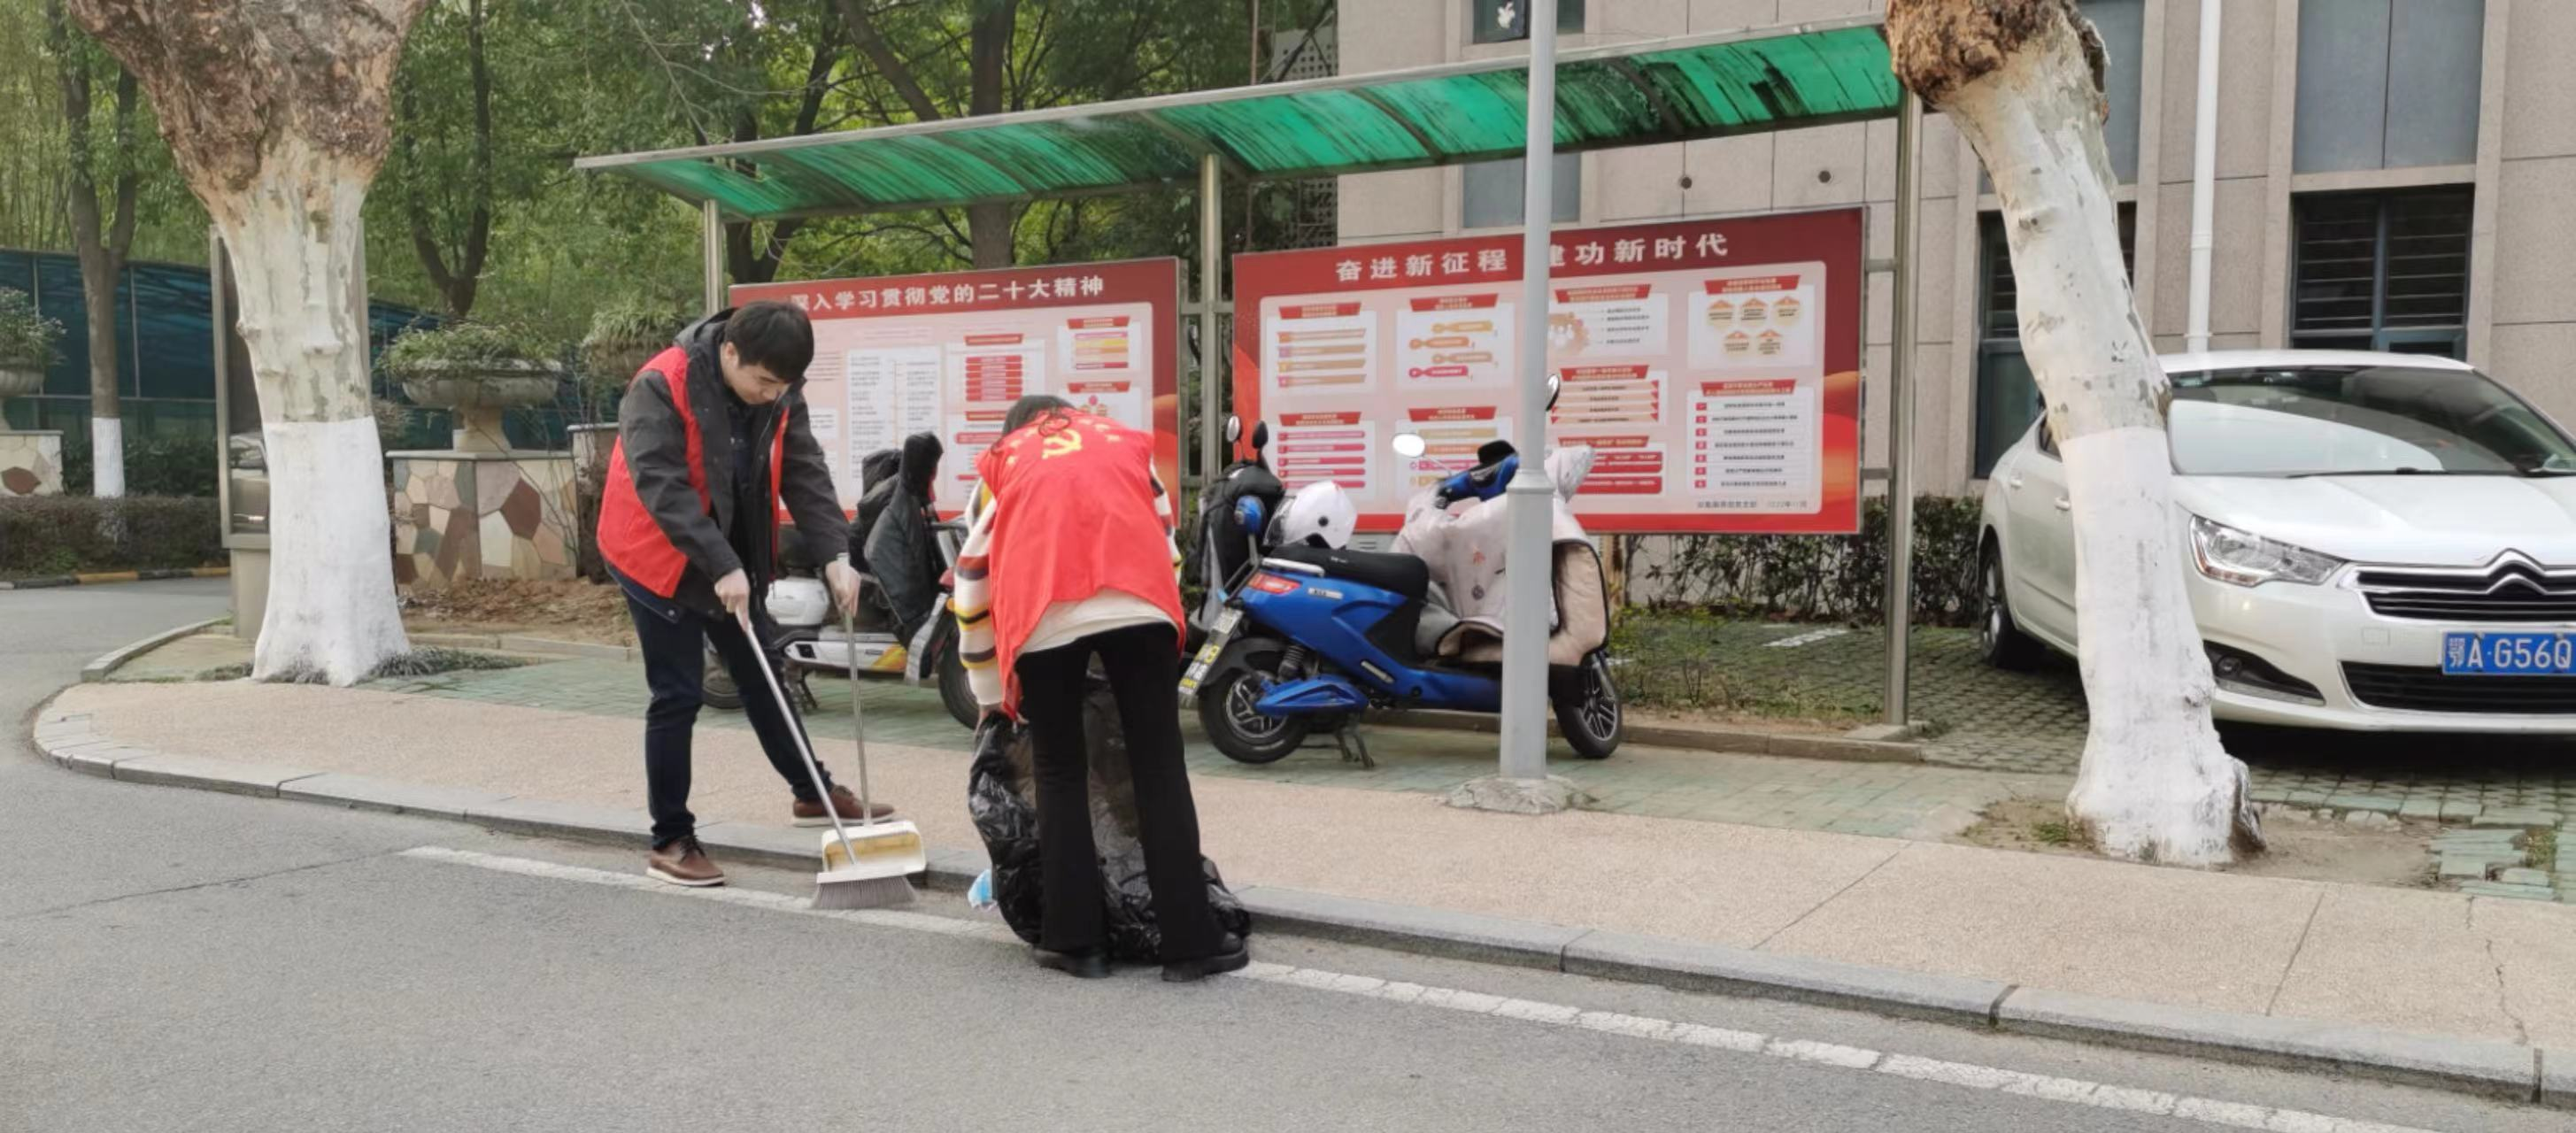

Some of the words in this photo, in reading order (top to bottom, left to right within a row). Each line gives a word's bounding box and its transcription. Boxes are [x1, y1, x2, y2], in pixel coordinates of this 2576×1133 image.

[1336, 249, 1507, 281] 奋进新征程
